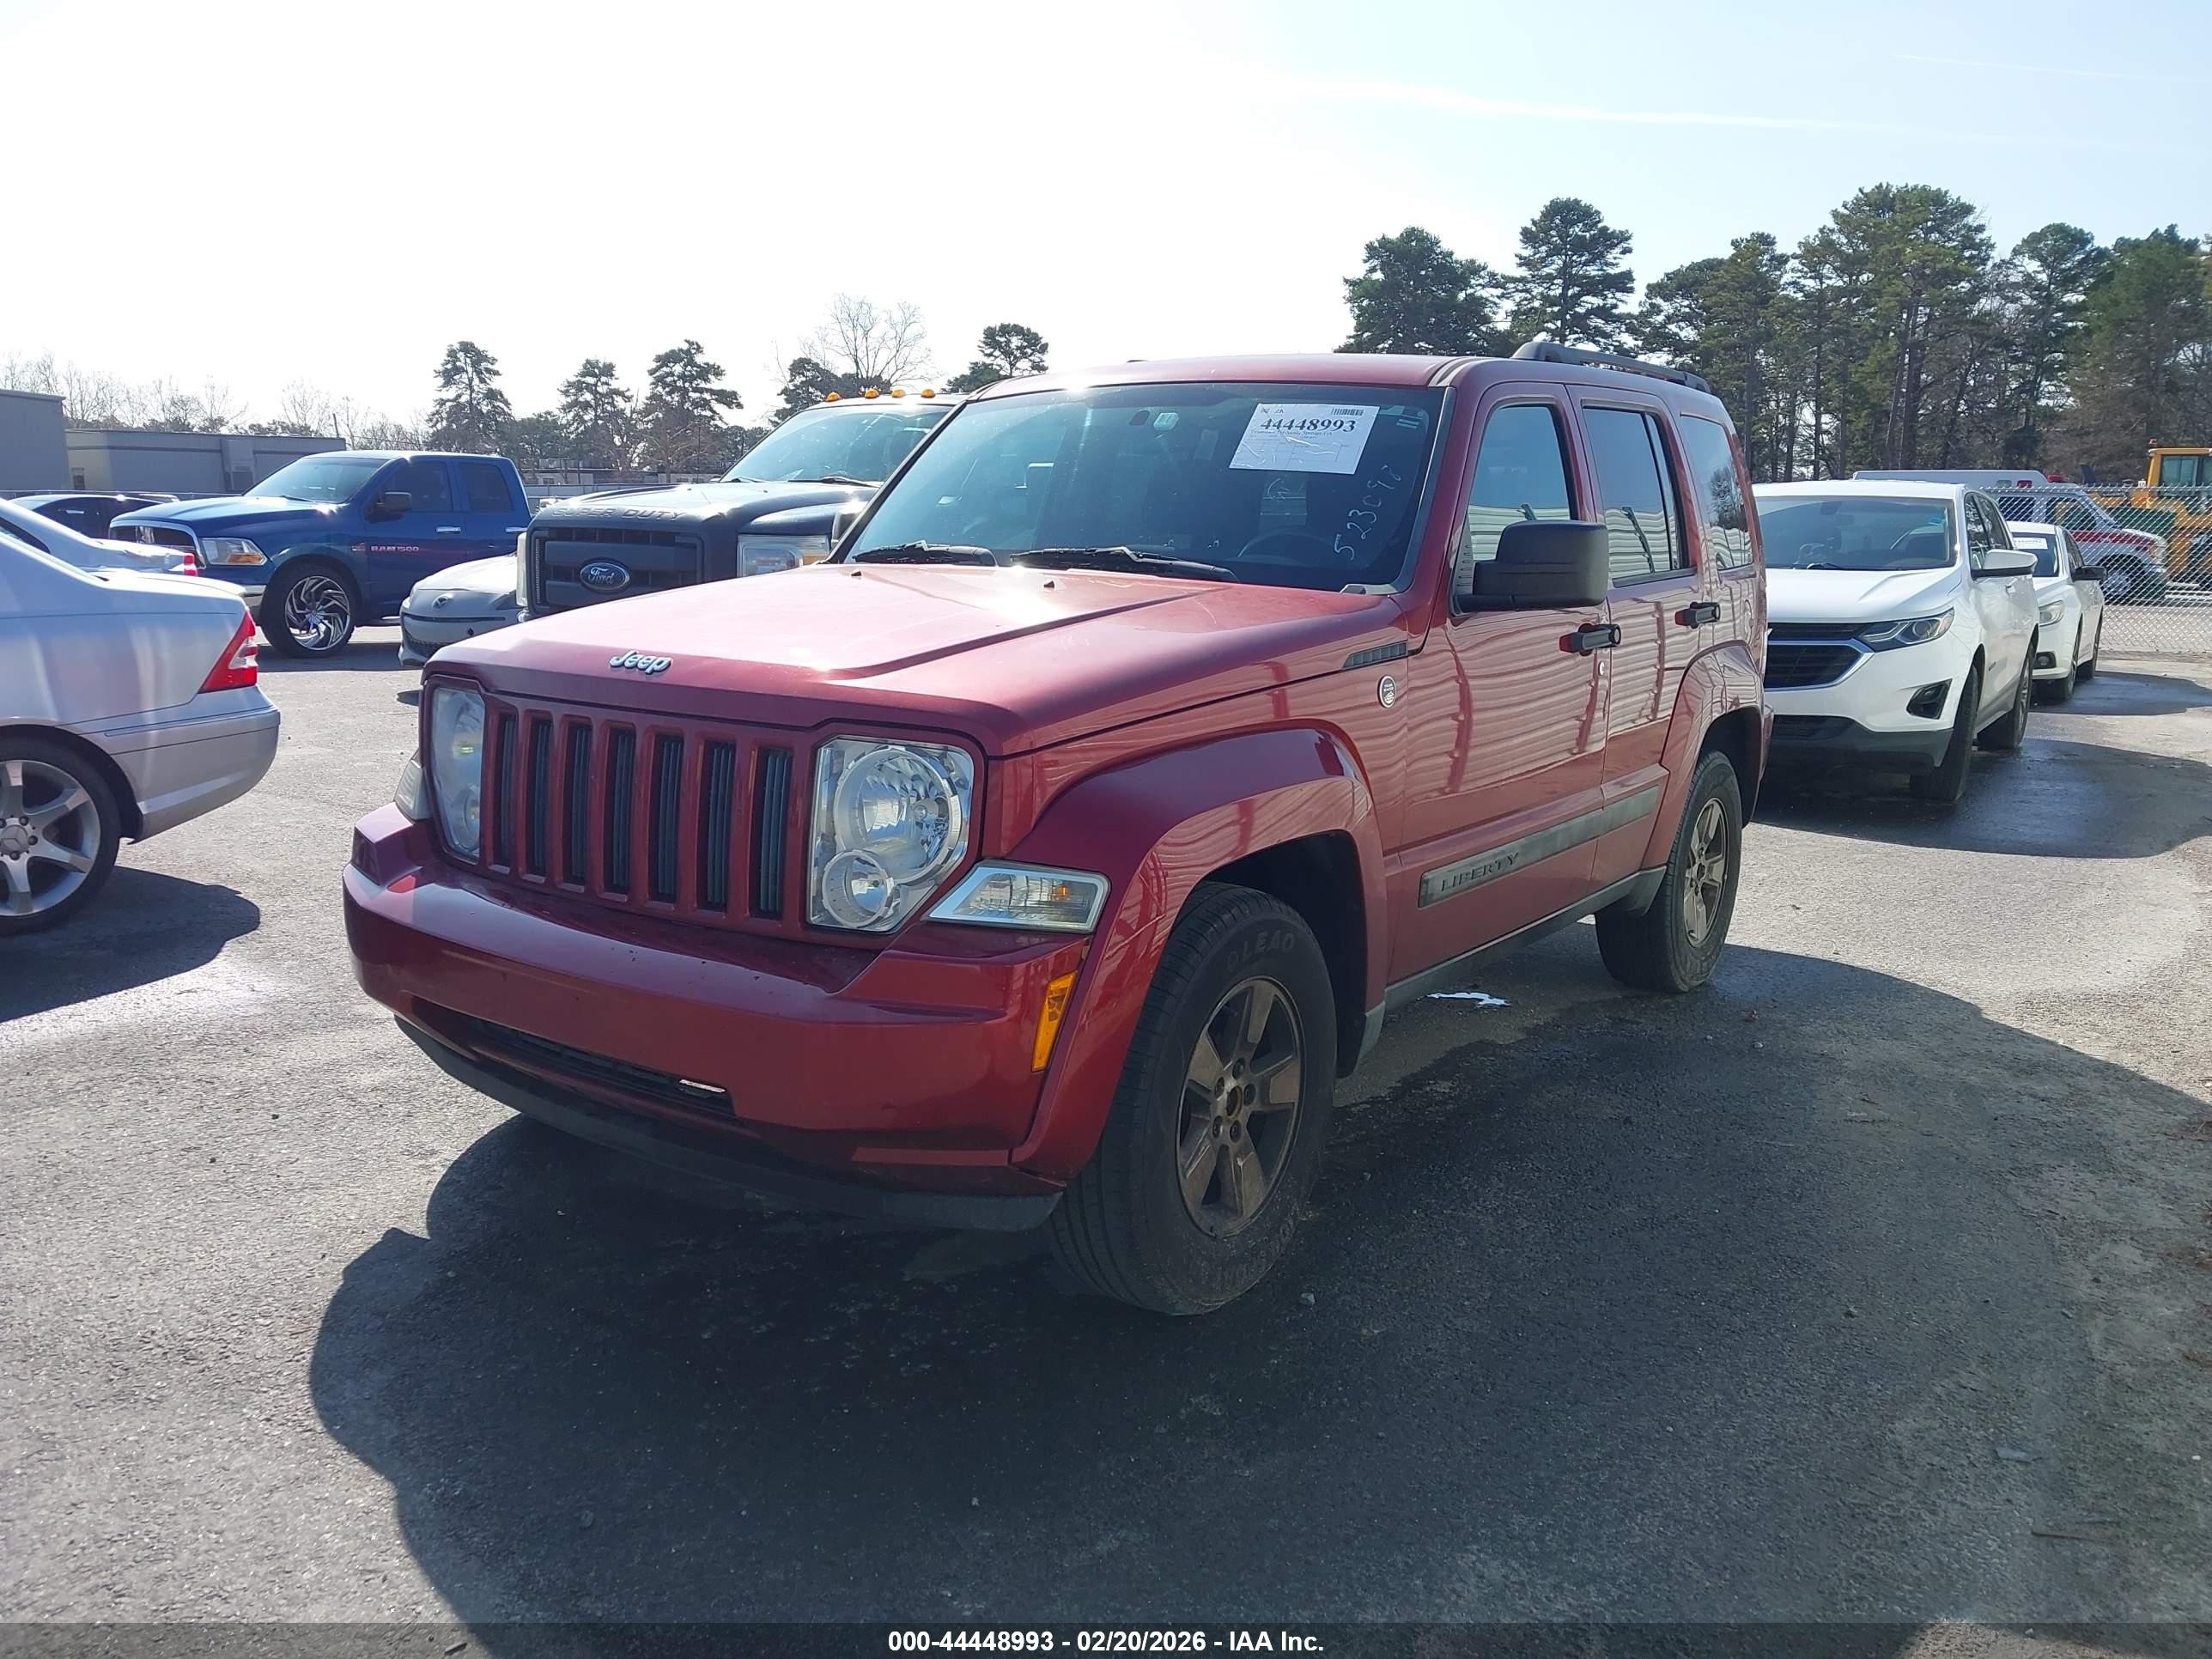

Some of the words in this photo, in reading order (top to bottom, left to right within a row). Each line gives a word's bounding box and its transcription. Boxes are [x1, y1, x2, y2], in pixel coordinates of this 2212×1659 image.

[1260, 418, 1357, 433] 44448993
[550, 507, 617, 519] SUPER
[621, 509, 688, 521] DUTY
[588, 566, 615, 585] Ford
[608, 650, 674, 674] Jeep
[1441, 853, 1518, 892] LIBERTY
